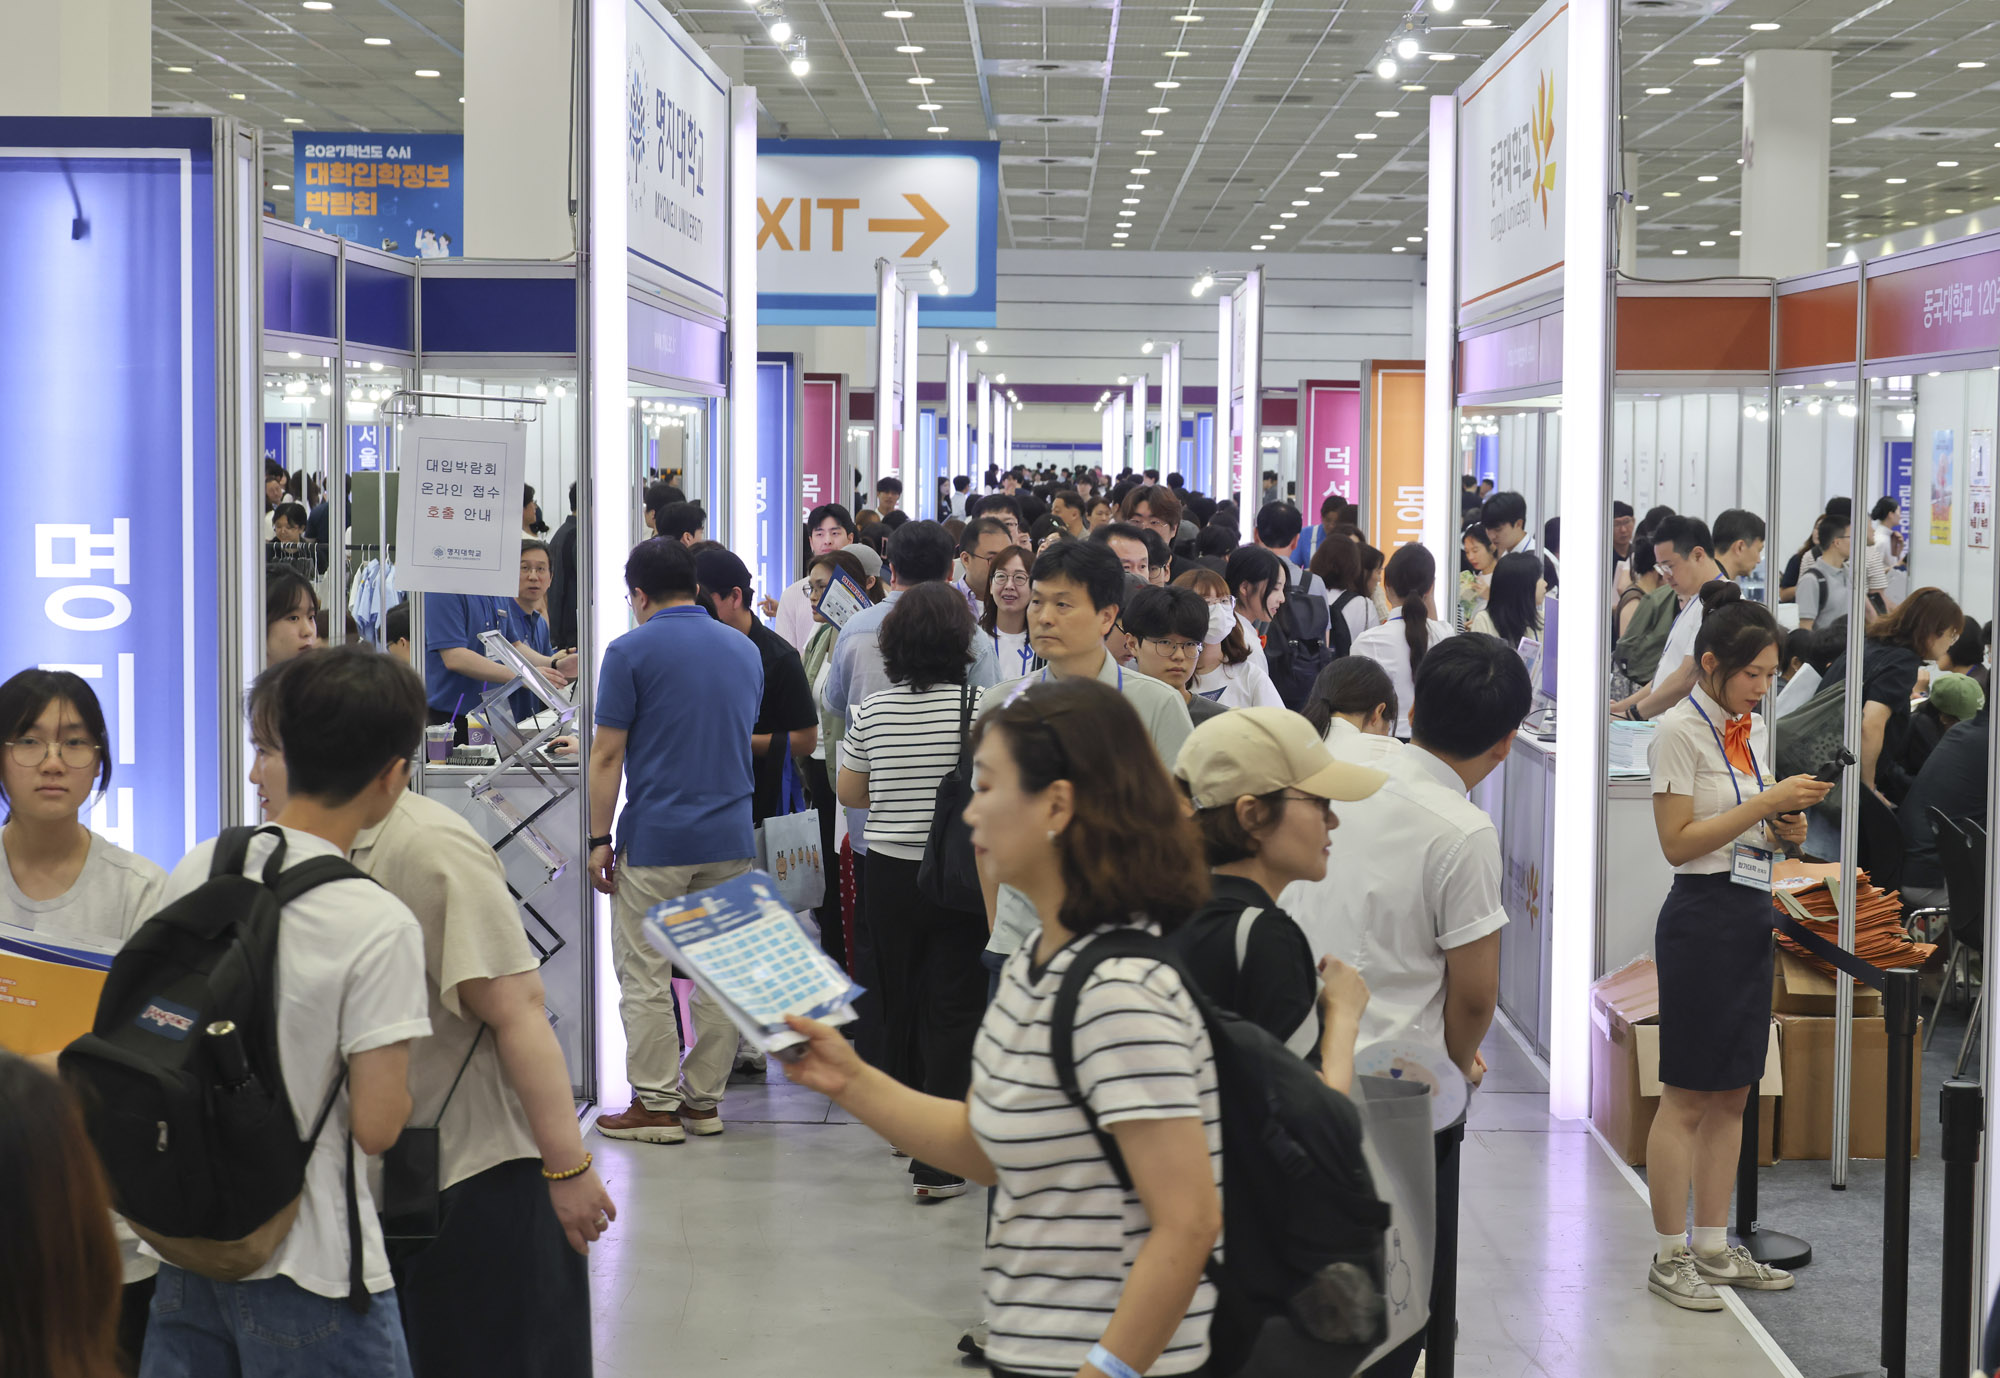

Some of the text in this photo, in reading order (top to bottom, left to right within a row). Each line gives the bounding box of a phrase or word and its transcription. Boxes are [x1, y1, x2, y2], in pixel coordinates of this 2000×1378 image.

[305, 144, 411, 159] 2027학년도 수시
[656, 87, 704, 198] 명지대학교
[305, 162, 450, 189] 대학입학정보
[1490, 122, 1531, 208] 동국대학교
[306, 191, 377, 216] 박람회
[757, 197, 860, 252] XIT
[1923, 283, 1974, 329] 동국대학교
[426, 459, 496, 475] 대입박람회
[421, 482, 499, 498] 온라인 접수
[427, 505, 490, 521] 호출 안내
[447, 548, 482, 557] 명지대학교
